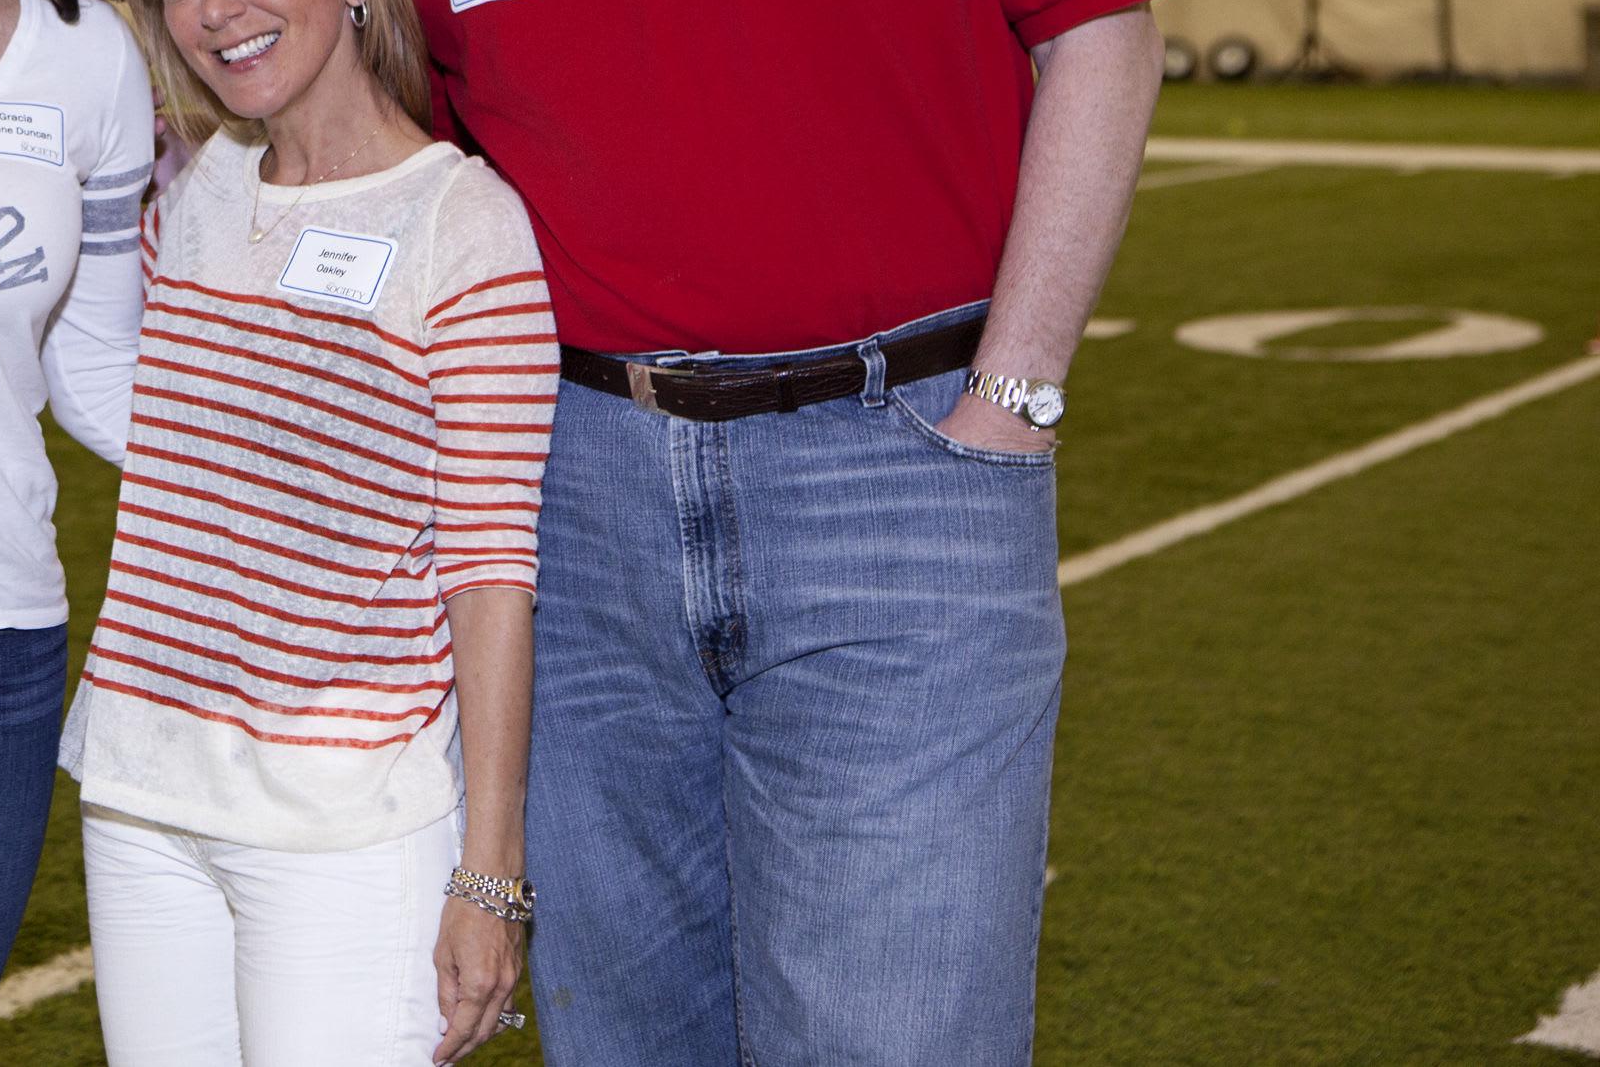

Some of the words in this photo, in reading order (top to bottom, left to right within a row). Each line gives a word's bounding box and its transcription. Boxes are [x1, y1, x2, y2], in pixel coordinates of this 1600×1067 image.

[16, 126, 53, 140] Duncan
[318, 248, 358, 263] Jennifer
[316, 263, 347, 278] Oakley
